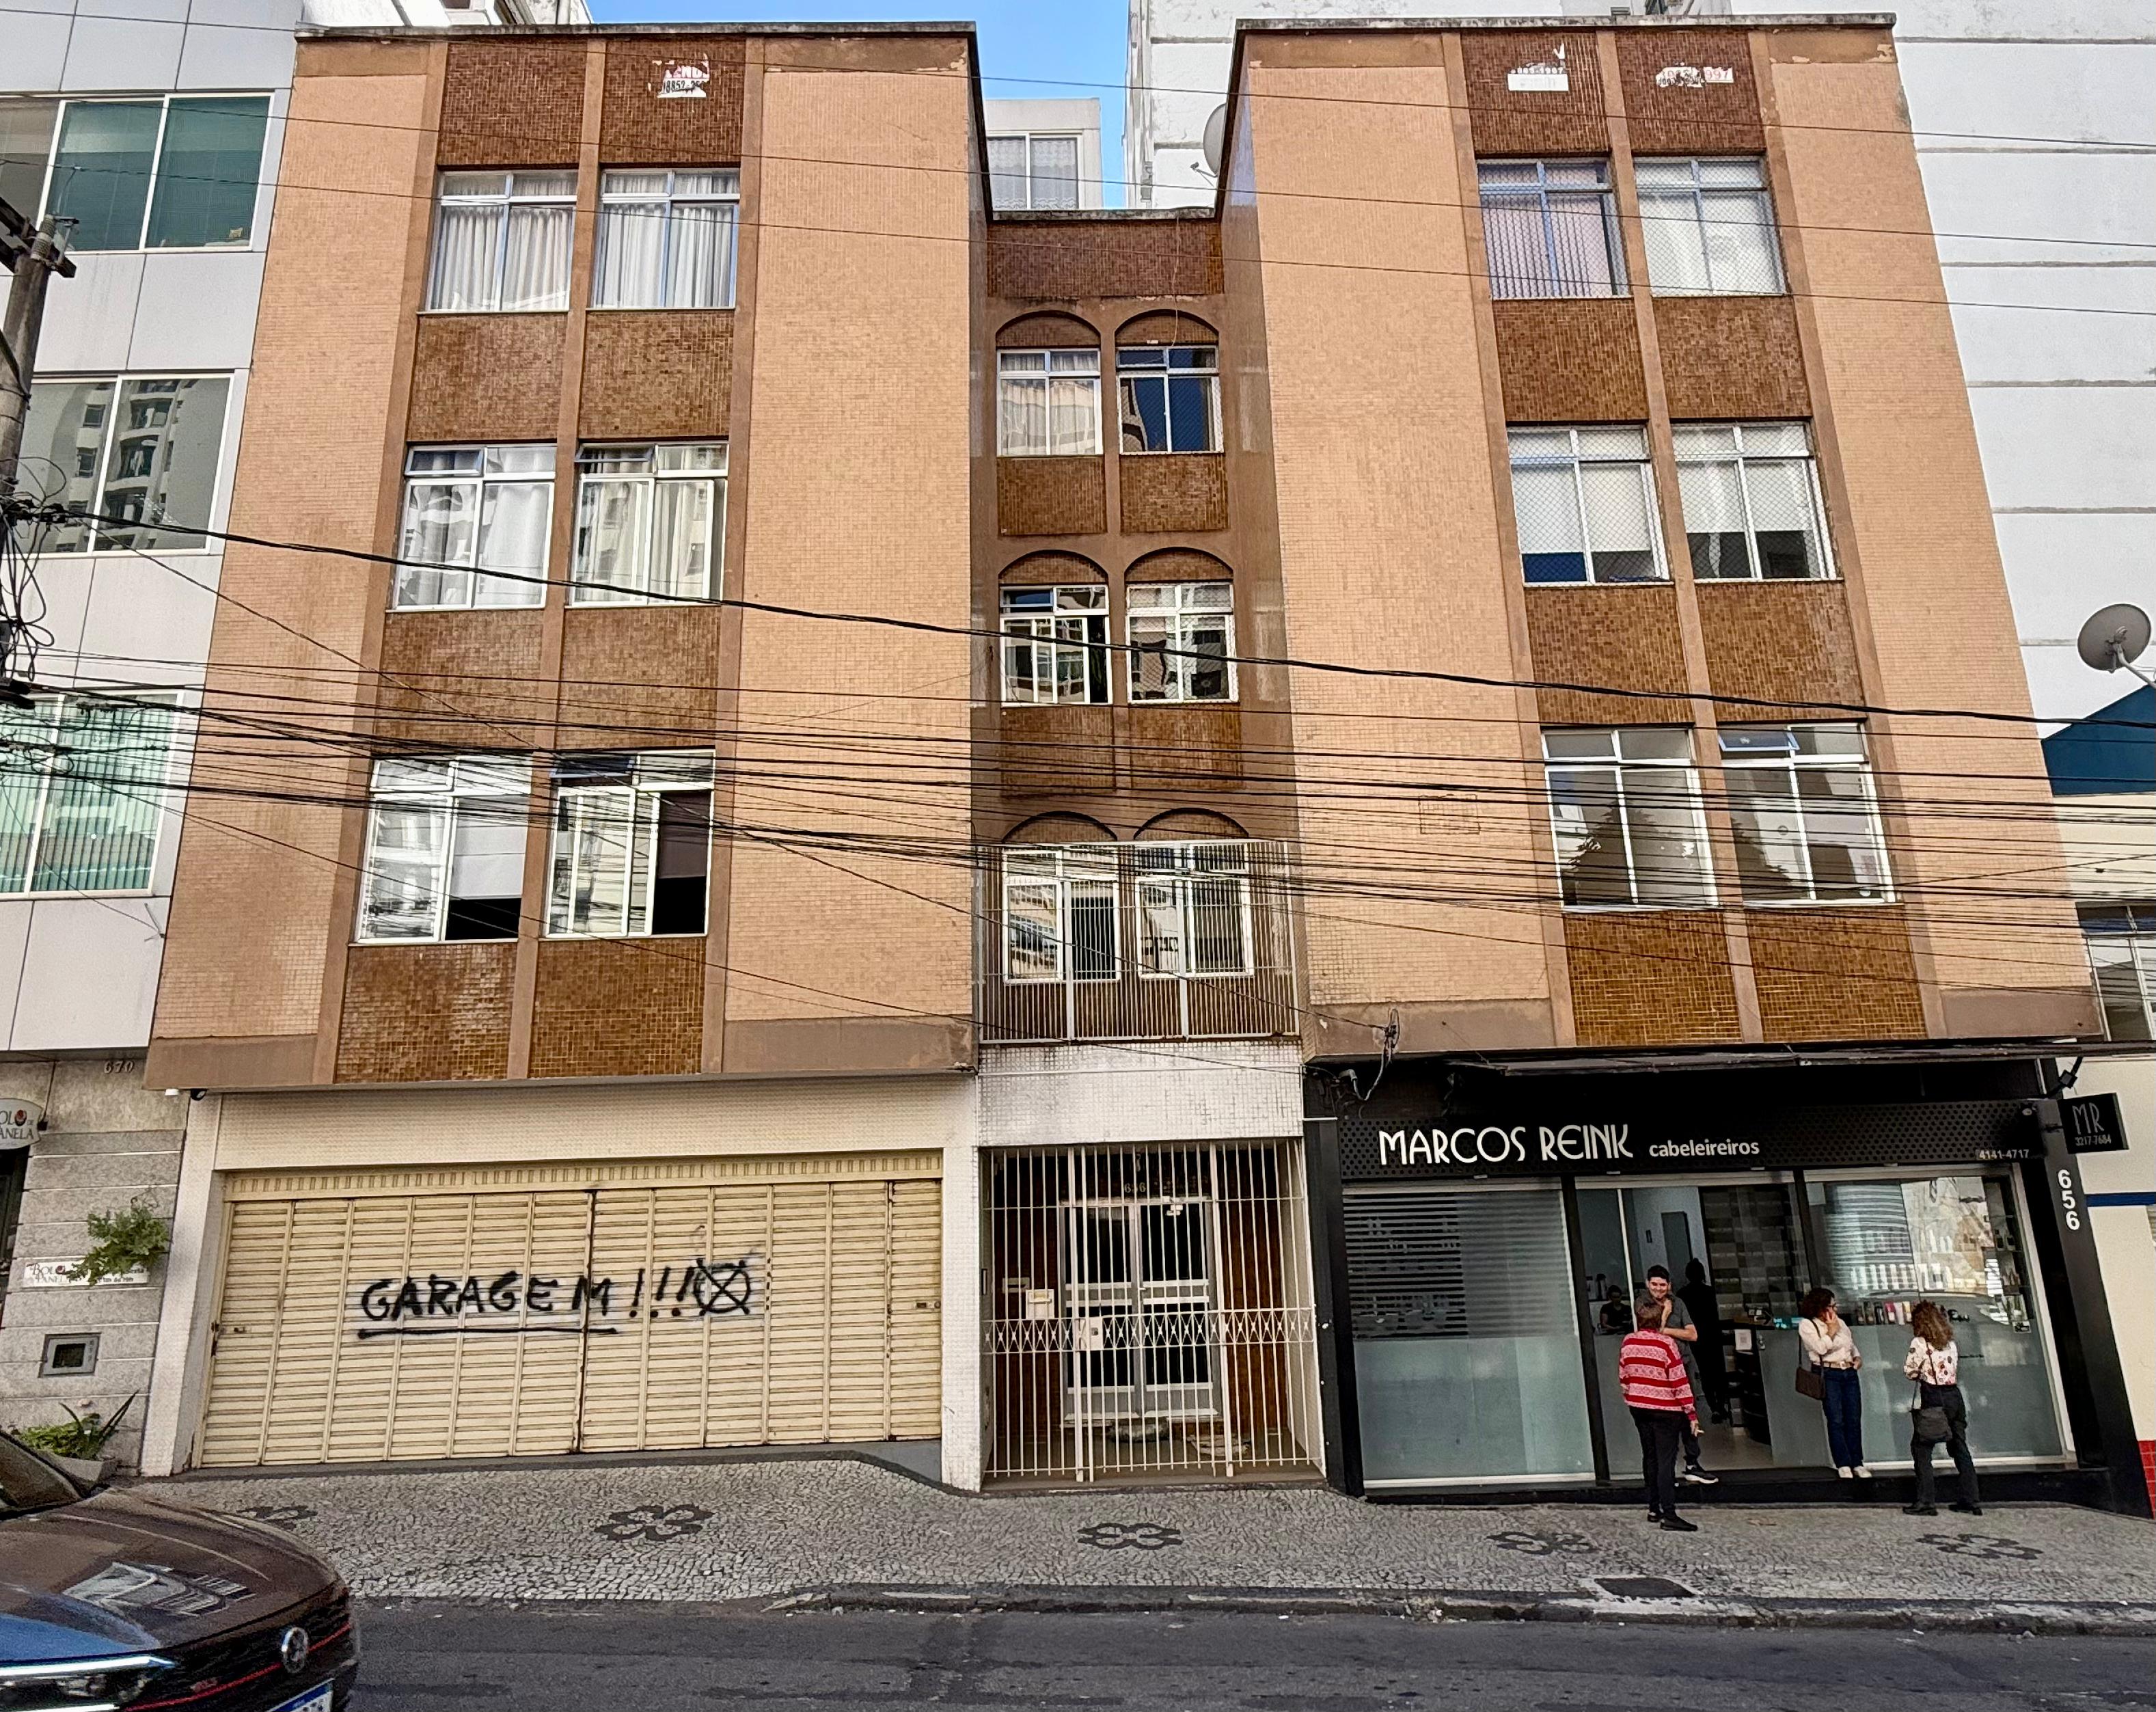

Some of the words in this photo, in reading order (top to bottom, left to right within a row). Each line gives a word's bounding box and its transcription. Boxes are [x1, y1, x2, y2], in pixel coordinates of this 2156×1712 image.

[104, 1060, 135, 1074] 670
[2072, 1102, 2105, 1134] MR
[1378, 1126, 1526, 1165] MARCOS
[1539, 1124, 1633, 1161] REINK
[1648, 1138, 1760, 1158] cabeleireiros
[2057, 1169, 2080, 1231] 656
